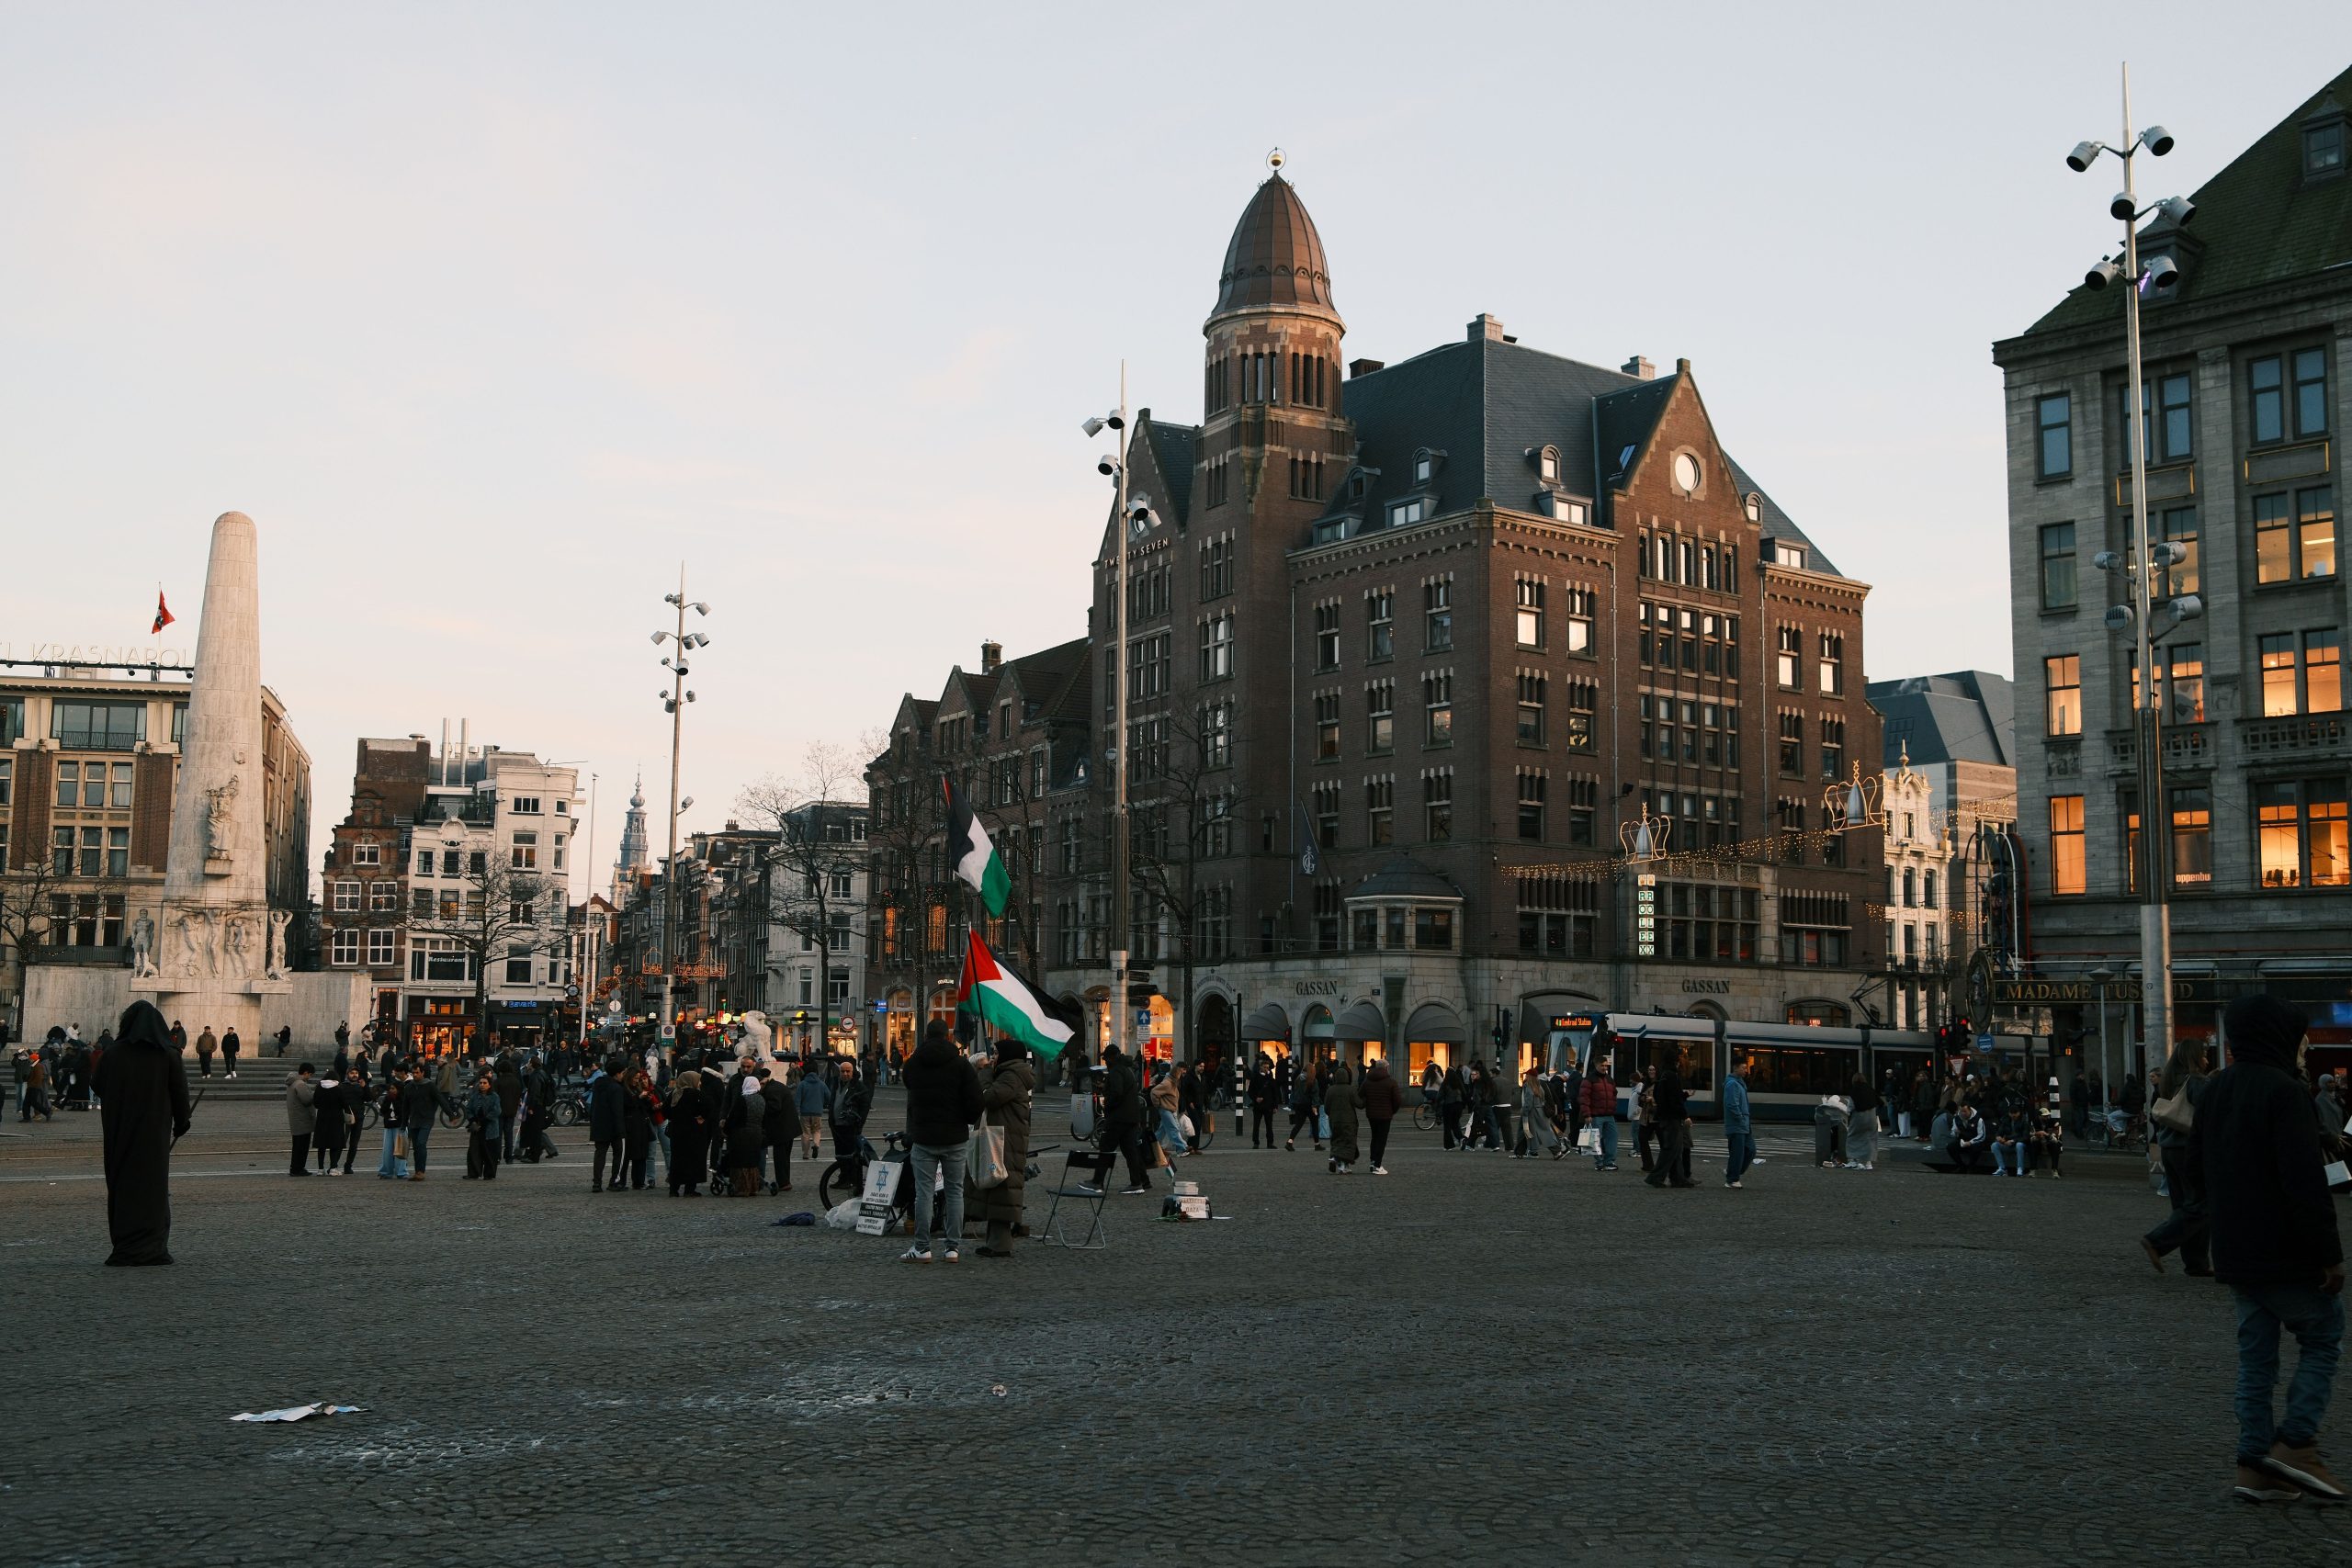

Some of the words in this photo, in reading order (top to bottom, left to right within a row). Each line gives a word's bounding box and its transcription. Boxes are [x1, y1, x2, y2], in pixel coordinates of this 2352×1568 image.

[1296, 981, 1337, 996] GASSAN
[1682, 979, 1730, 994] GASSAN
[2006, 984, 2092, 1000] MADAME
[2103, 983, 2194, 999] TUSD
[508, 1000, 537, 1009] Bavaria
[1578, 1017, 1592, 1026] Station
